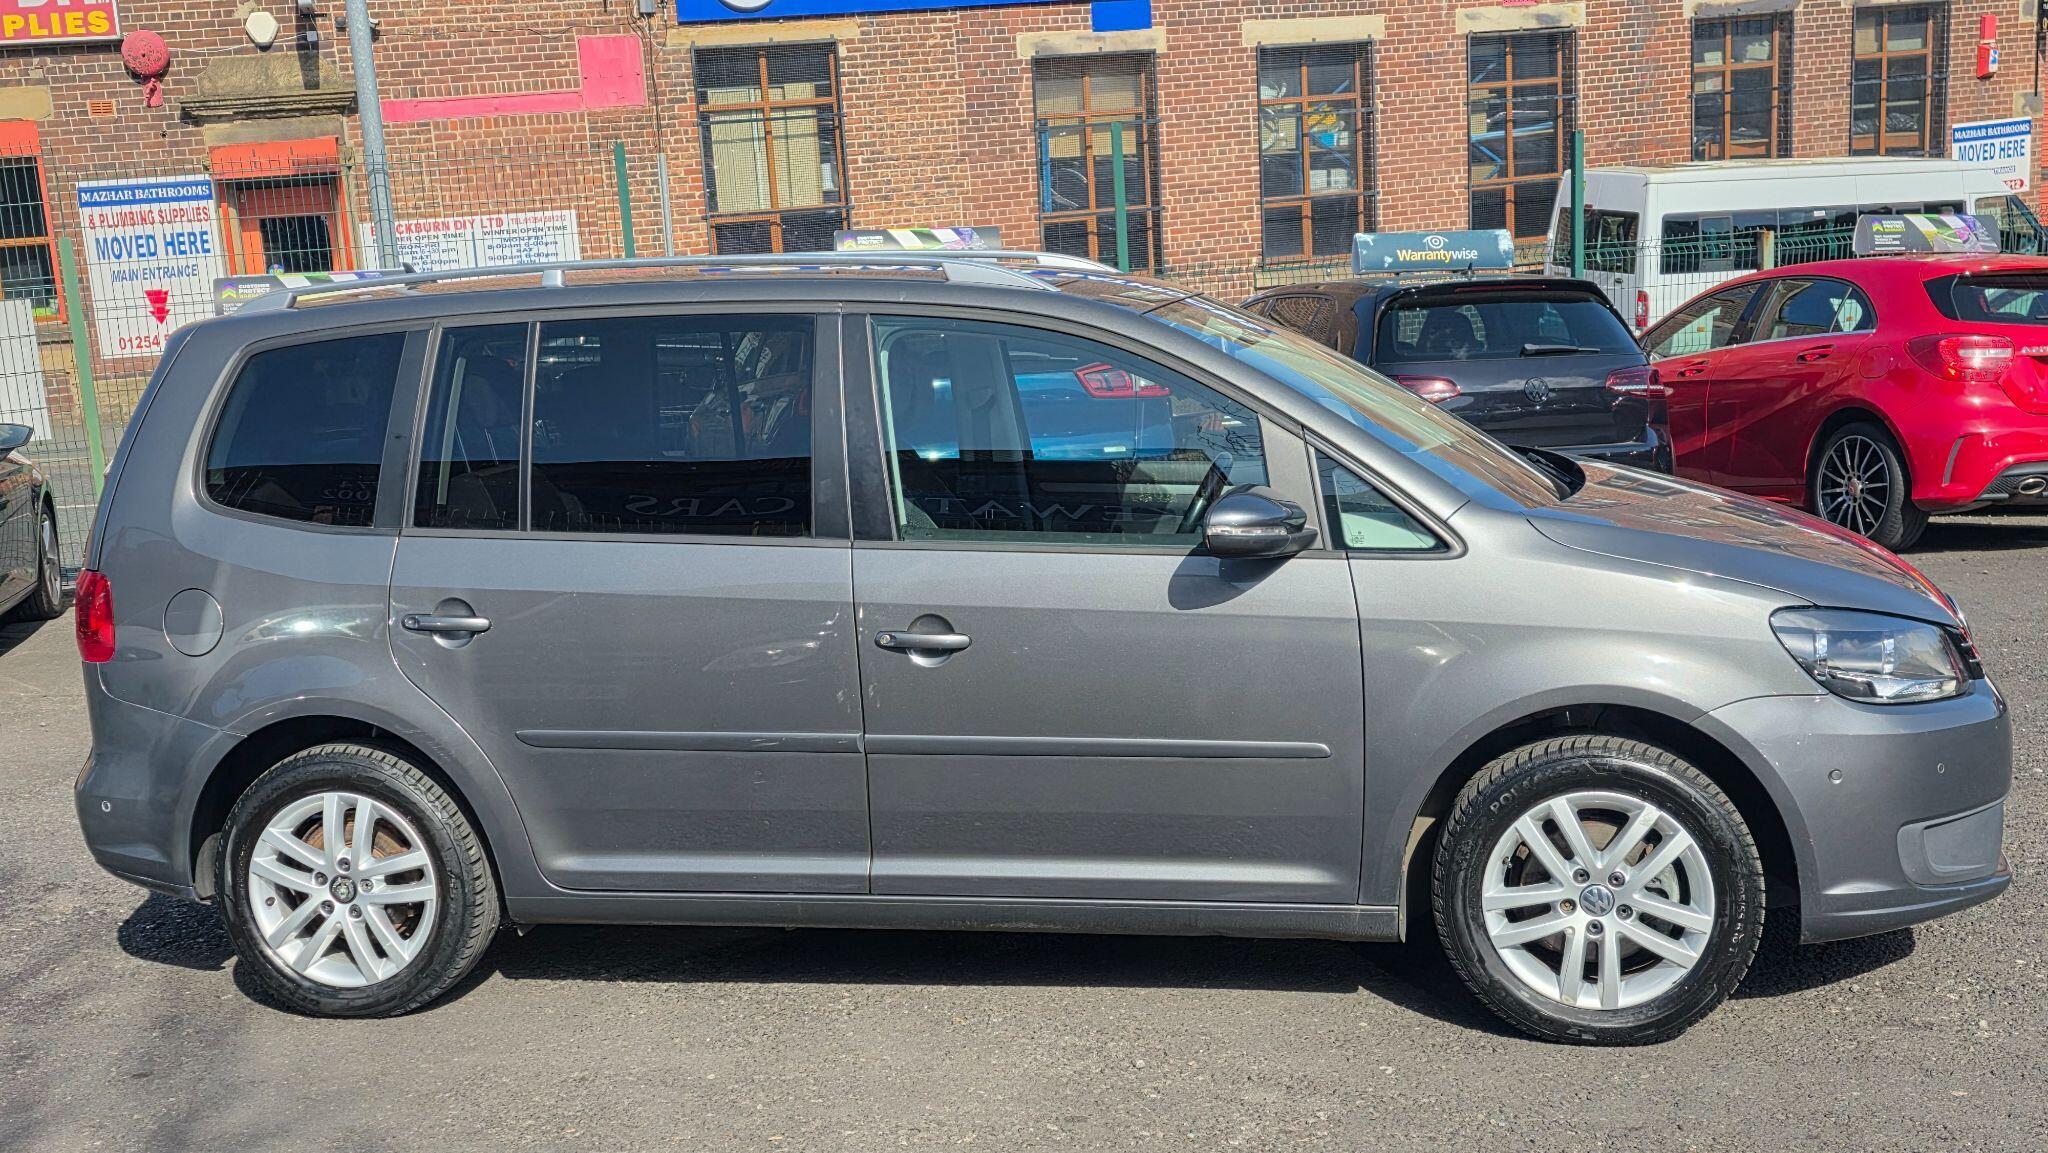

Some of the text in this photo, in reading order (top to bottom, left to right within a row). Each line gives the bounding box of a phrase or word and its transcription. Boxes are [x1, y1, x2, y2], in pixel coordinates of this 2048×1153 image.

[3, 10, 110, 37] PLIES
[1954, 123, 2030, 139] MAZHAR BATHROOMS
[1958, 139, 2025, 161] MOVED HERE
[80, 184, 210, 203] MAZHAR BATHROOMS
[88, 205, 209, 229] & PLUMBING SUPPLIES
[370, 220, 450, 238] BCKBURN
[454, 218, 476, 231] DIY
[481, 216, 504, 229] LTD
[482, 224, 568, 236] WINTER OPEN TIME
[95, 230, 211, 260] MOVED HERE
[1397, 247, 1478, 263] Warrantywise
[112, 264, 198, 282] MAIN ENTRANCE
[119, 335, 160, 350] 01254
